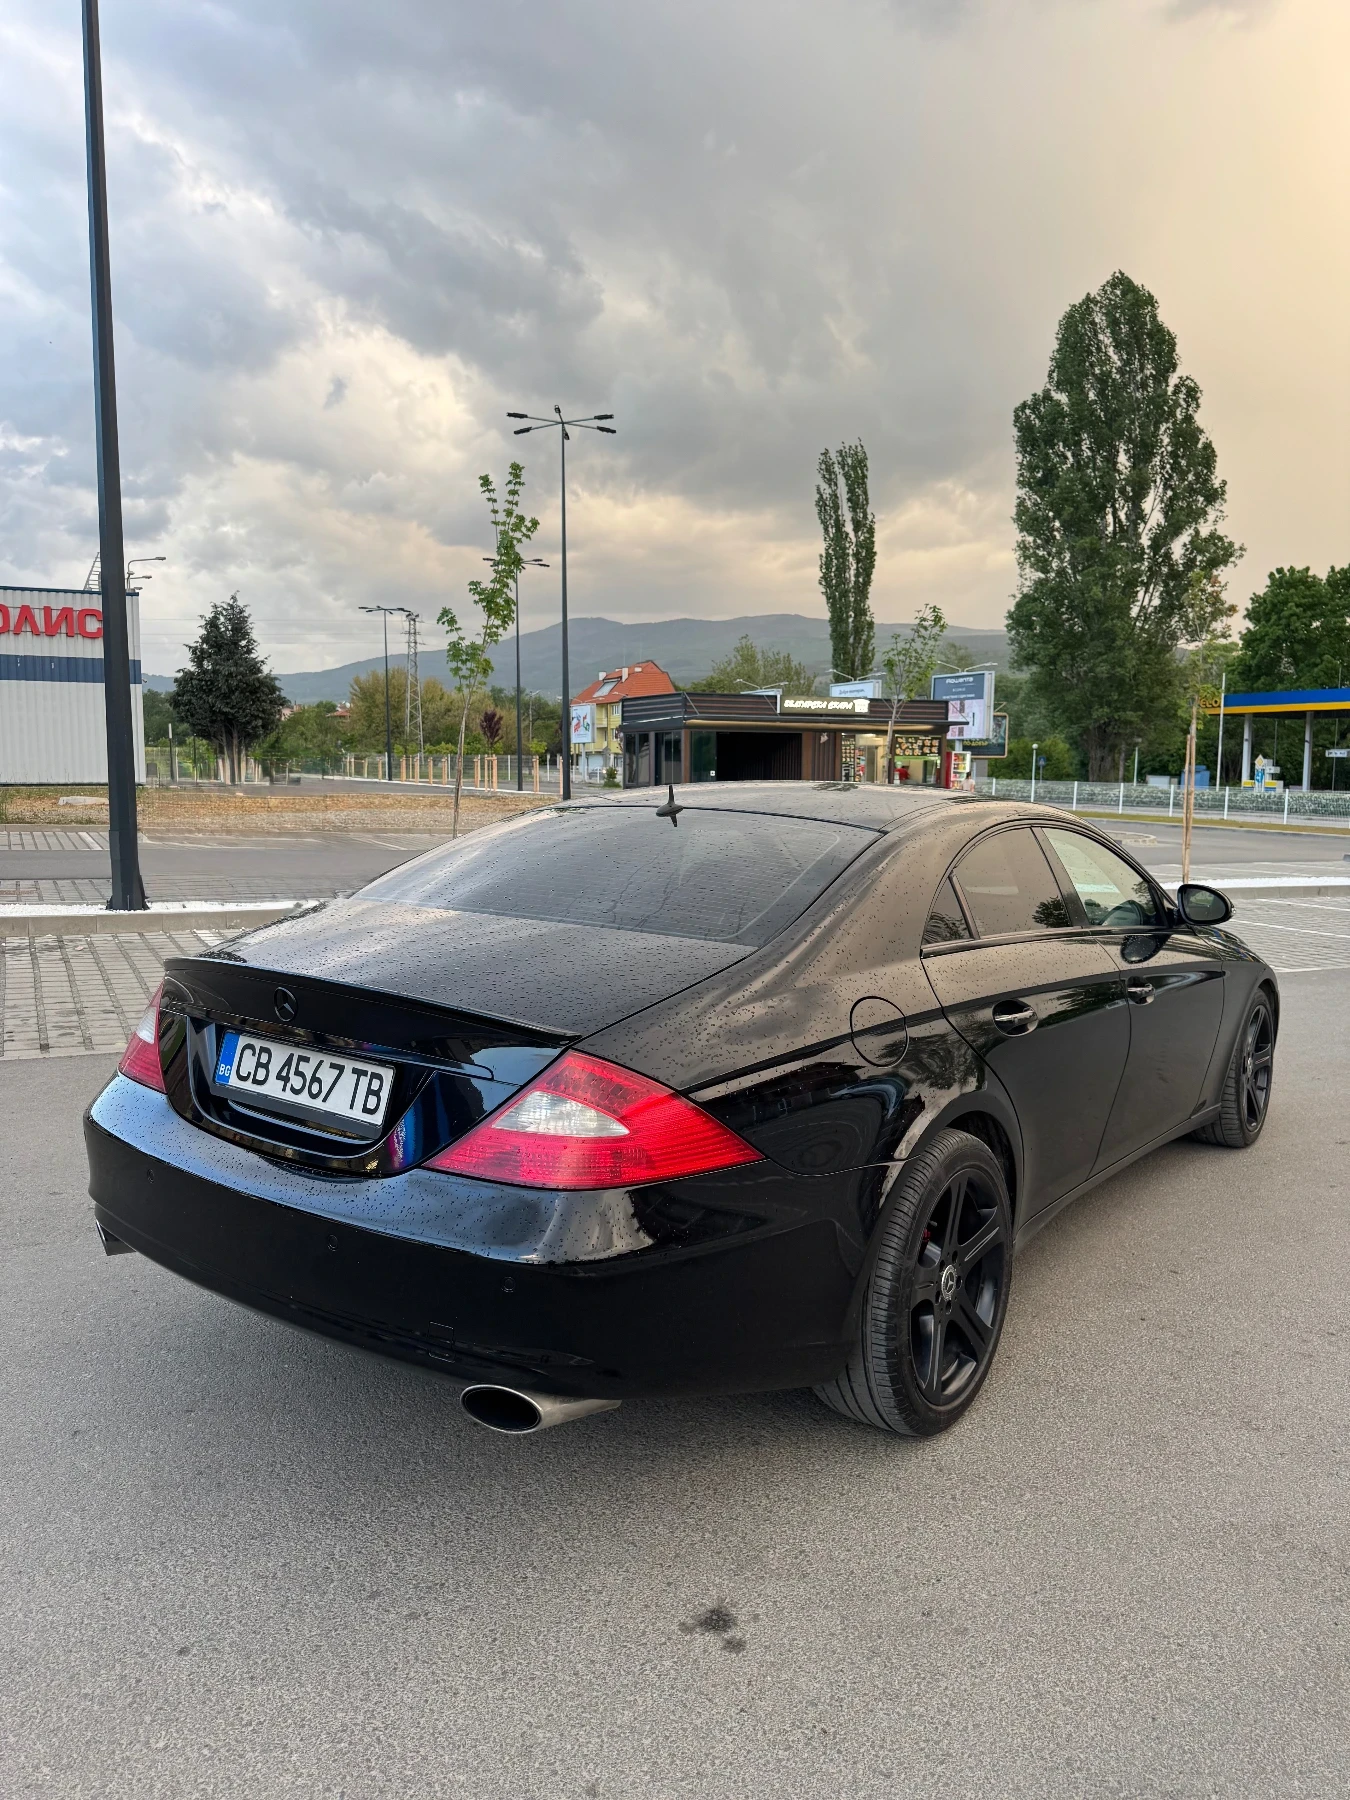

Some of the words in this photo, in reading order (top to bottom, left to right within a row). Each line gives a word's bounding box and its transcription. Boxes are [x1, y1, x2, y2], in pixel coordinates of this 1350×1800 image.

[218, 1063, 231, 1077] BG
[236, 1043, 273, 1086] CB
[275, 1053, 345, 1103] 4567
[350, 1066, 384, 1116] TB
